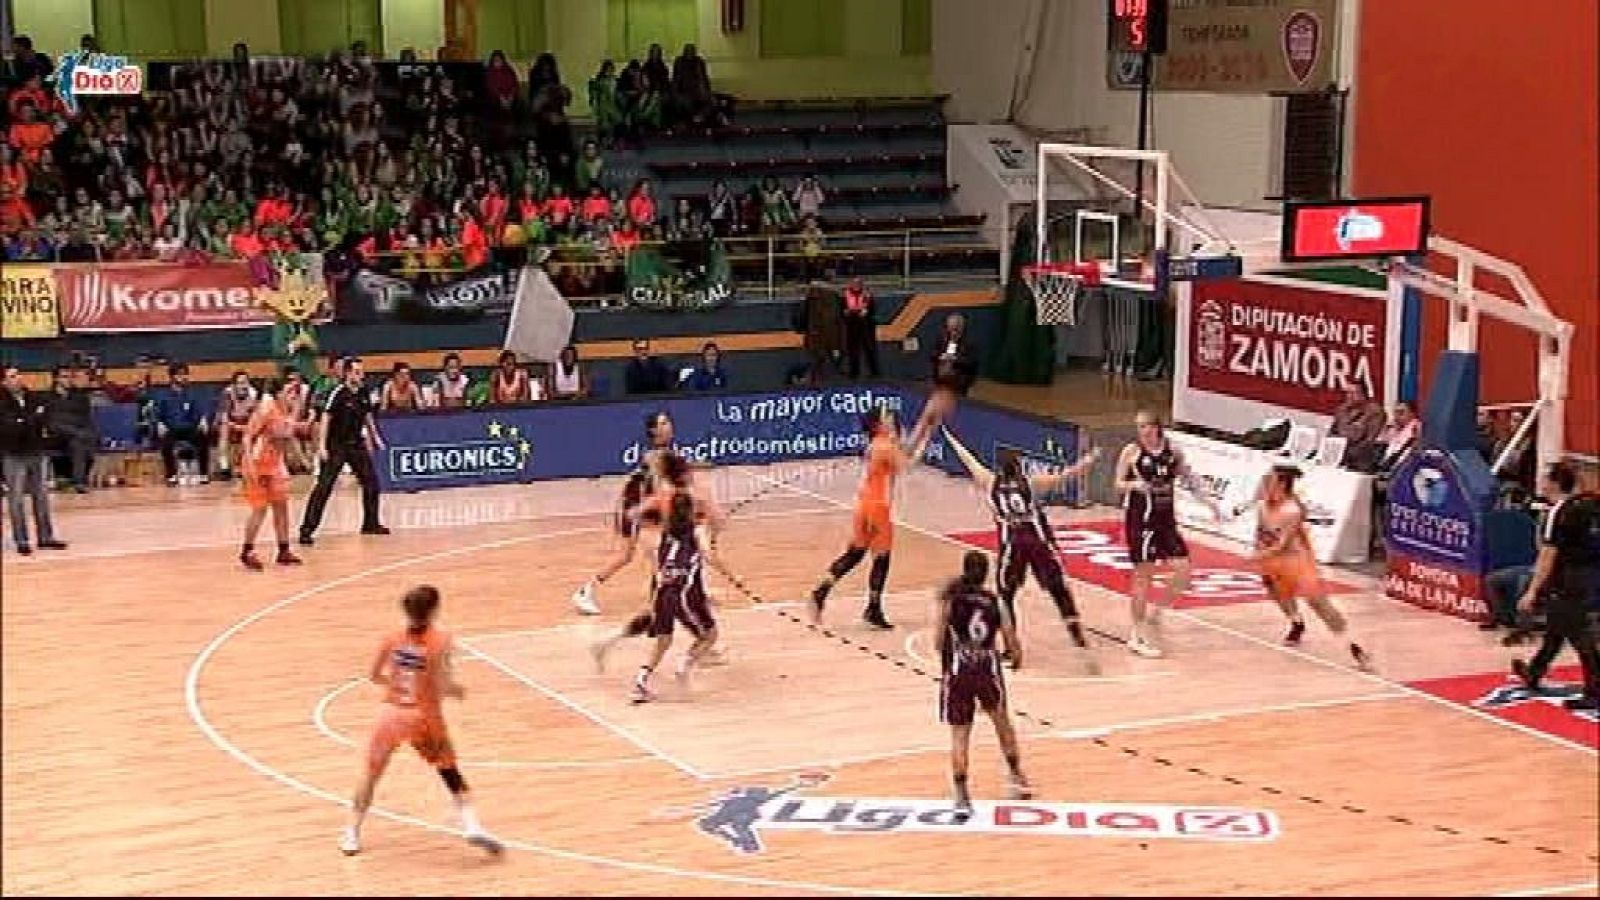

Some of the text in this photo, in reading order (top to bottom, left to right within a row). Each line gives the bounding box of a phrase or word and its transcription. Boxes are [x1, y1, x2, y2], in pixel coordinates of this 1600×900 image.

[1231, 304, 1376, 348] DIPUTACIÓN DE
[1229, 334, 1375, 398] ZAMORA
[750, 393, 823, 422] mayor
[401, 446, 516, 473] EURONICS
[968, 608, 988, 642] 6
